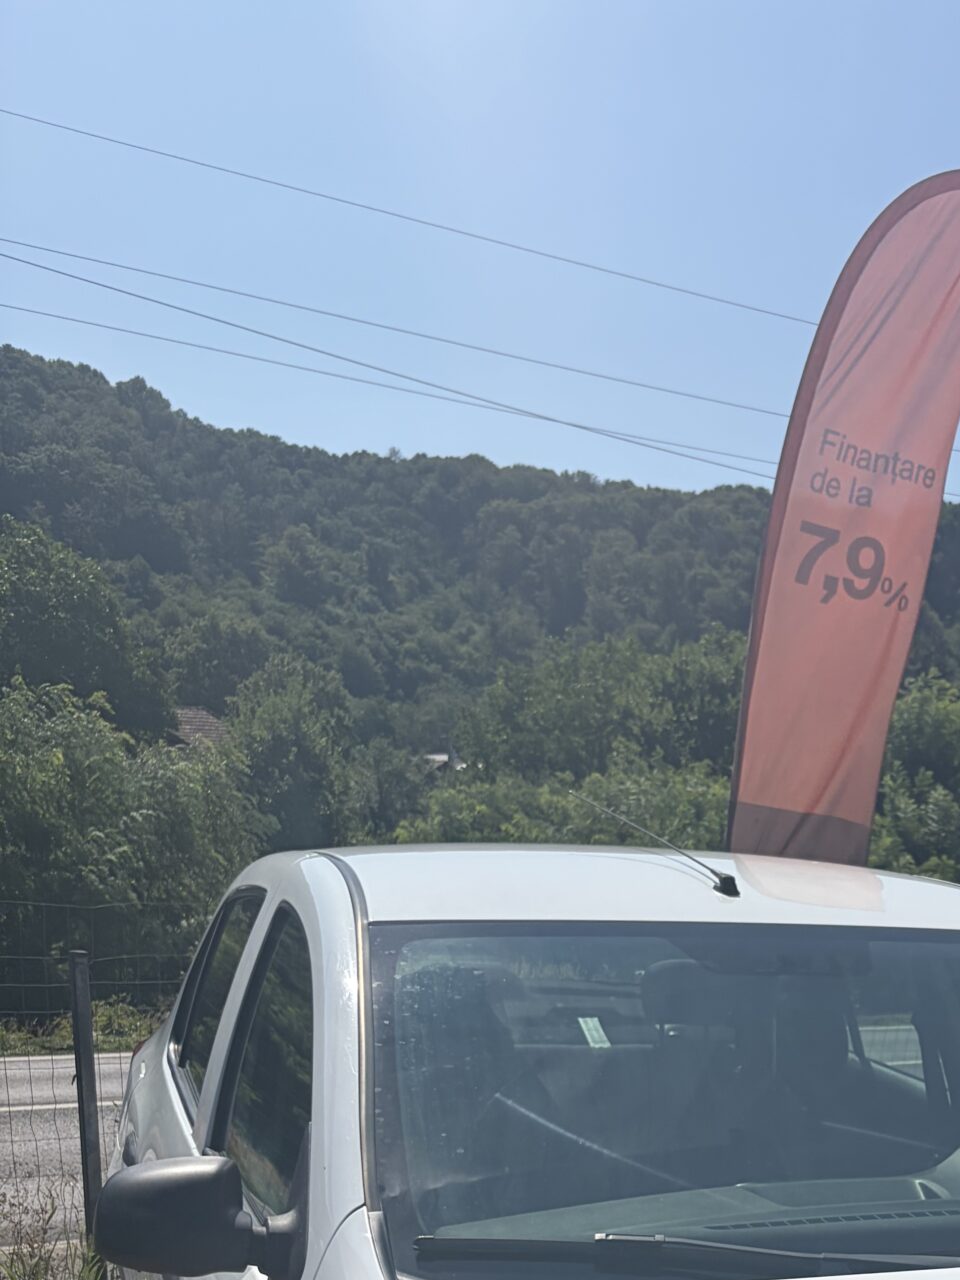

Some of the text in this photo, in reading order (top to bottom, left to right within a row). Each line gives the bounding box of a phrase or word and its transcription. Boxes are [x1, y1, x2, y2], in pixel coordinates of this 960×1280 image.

[809, 468, 874, 508] de la
[794, 520, 909, 612] 7,9%
